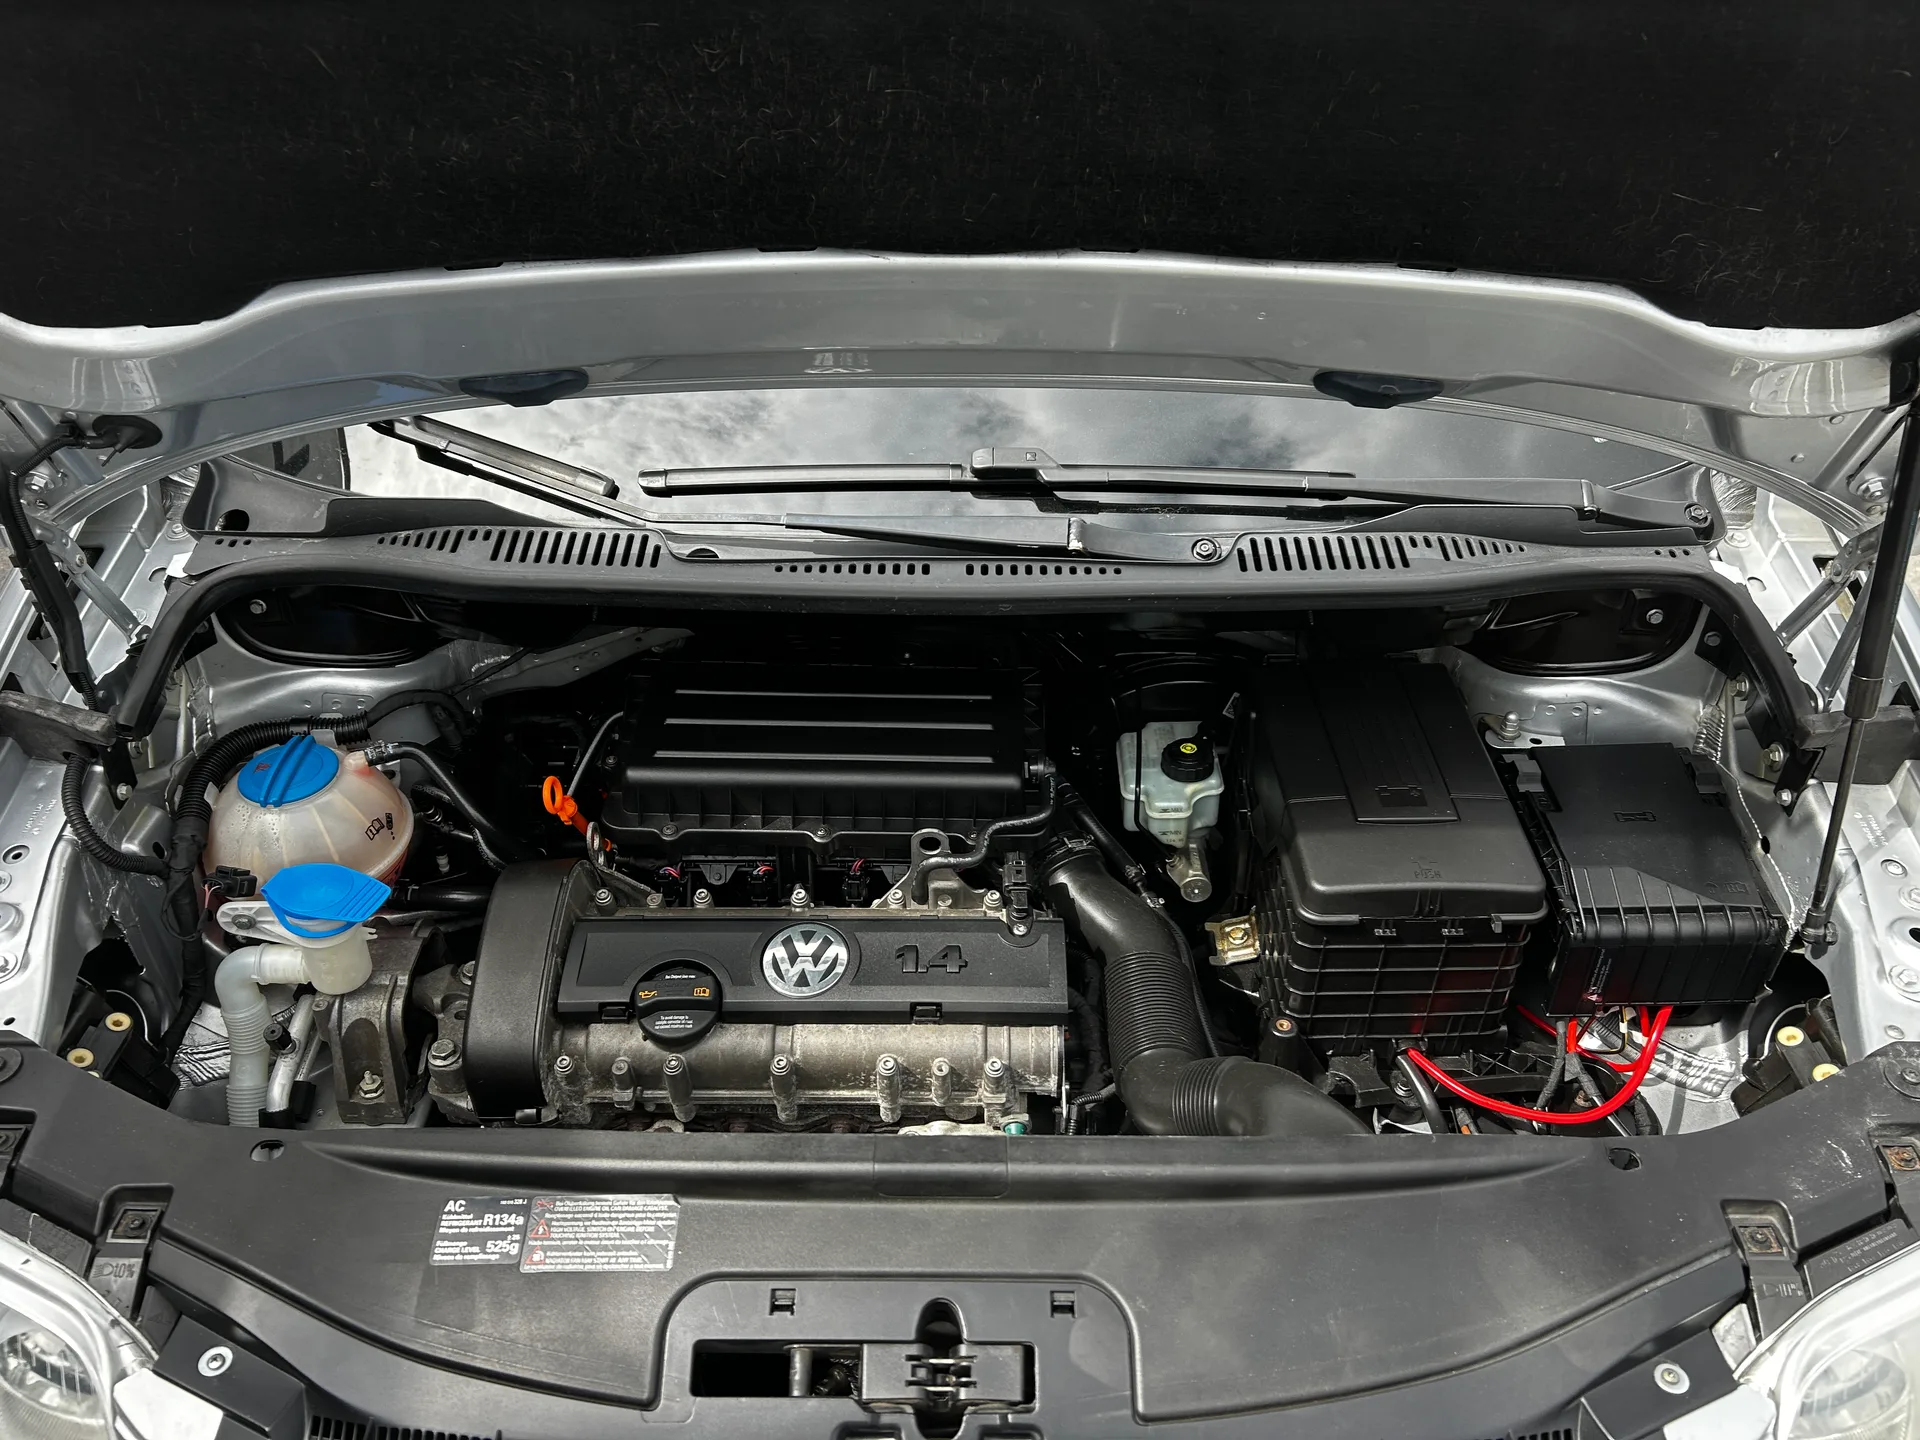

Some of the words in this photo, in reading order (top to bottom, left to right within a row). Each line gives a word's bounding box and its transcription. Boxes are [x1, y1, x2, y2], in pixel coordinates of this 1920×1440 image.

[762, 922, 849, 998] VW
[895, 944, 968, 973] 1.4
[444, 1200, 466, 1212] AC
[483, 1213, 524, 1226] R134a
[486, 1240, 519, 1255] 525g
